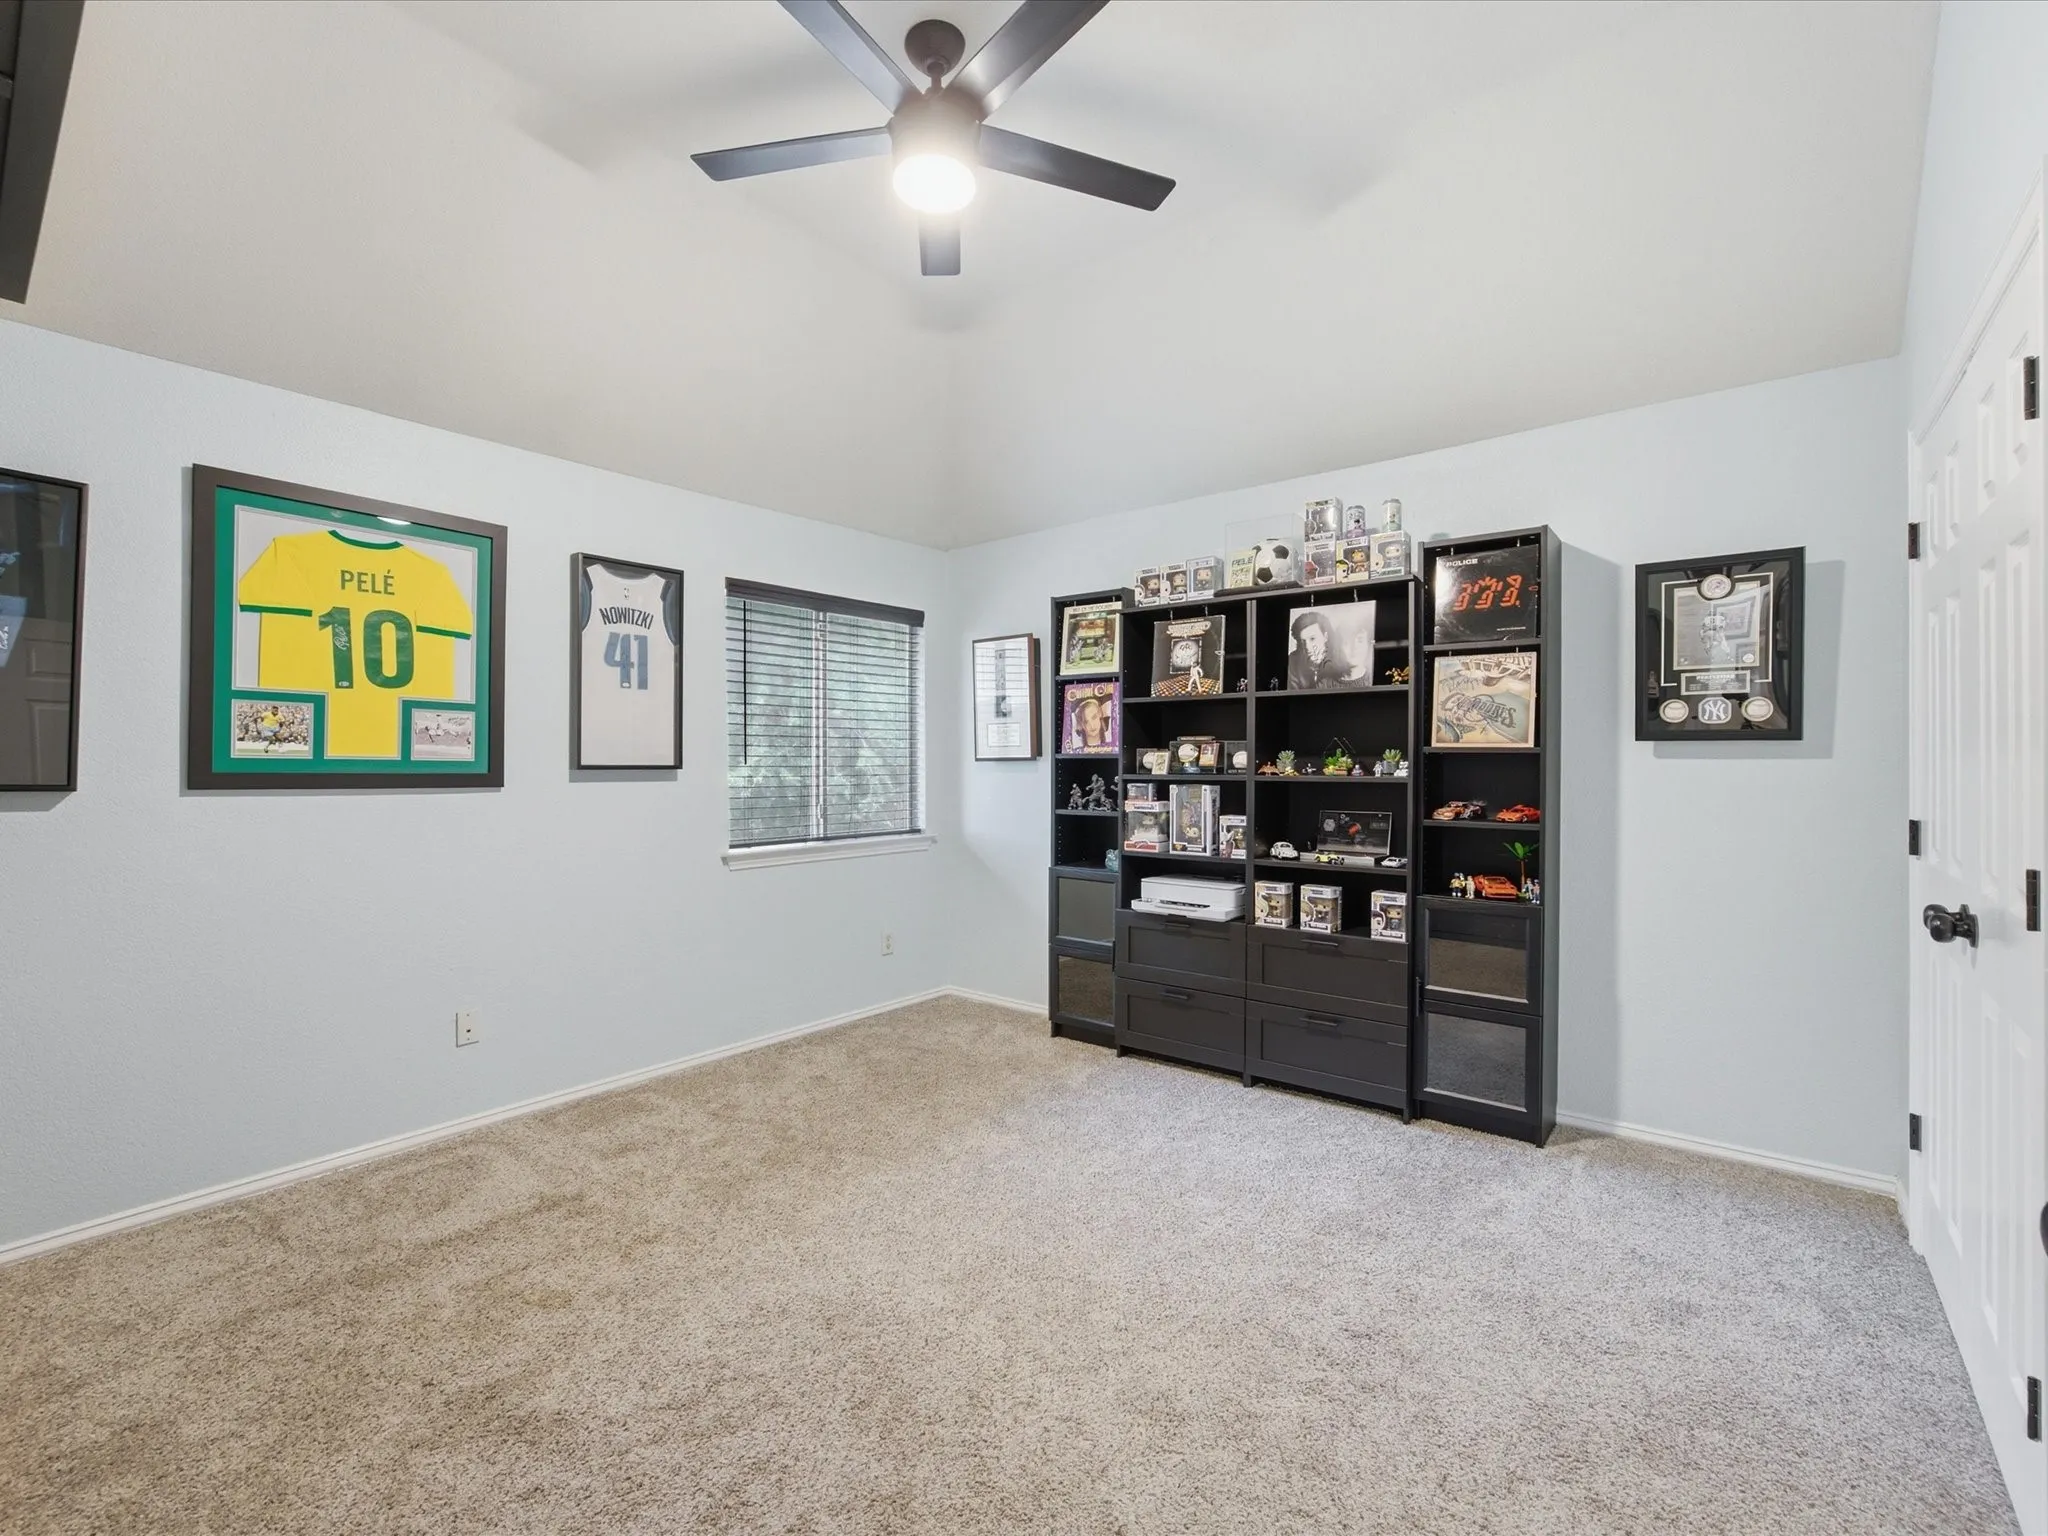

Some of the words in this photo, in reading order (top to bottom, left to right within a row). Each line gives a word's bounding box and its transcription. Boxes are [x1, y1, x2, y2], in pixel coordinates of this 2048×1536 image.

[1445, 558, 1479, 567] POLICE
[340, 569, 395, 595] PELÉ
[599, 606, 654, 630] NOWITZKI
[318, 606, 415, 689] 10
[603, 631, 649, 690] 41
